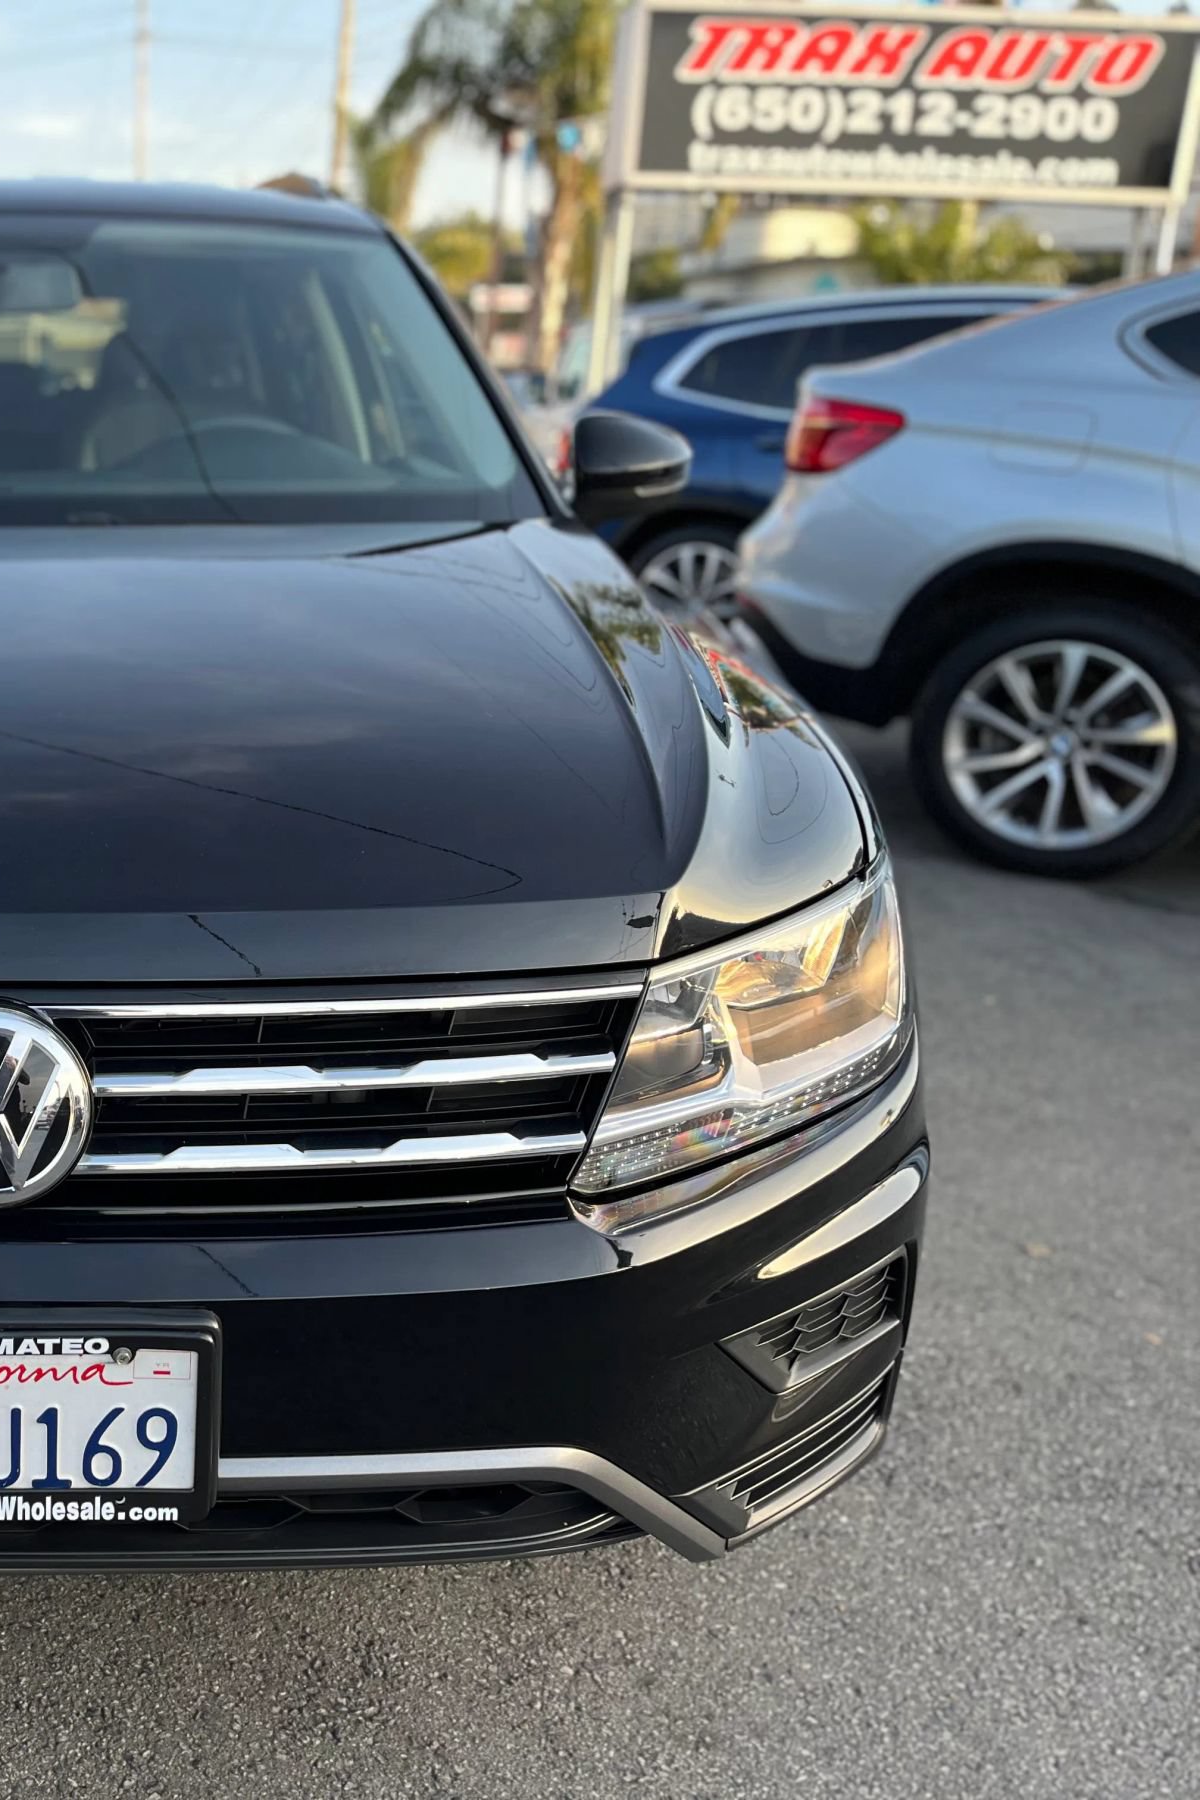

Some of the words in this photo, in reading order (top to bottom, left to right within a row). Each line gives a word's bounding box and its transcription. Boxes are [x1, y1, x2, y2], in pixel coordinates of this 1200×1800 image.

[674, 17, 928, 86] TRAX
[914, 26, 1166, 97] AUTO
[690, 86, 1119, 142] (650)212-2900
